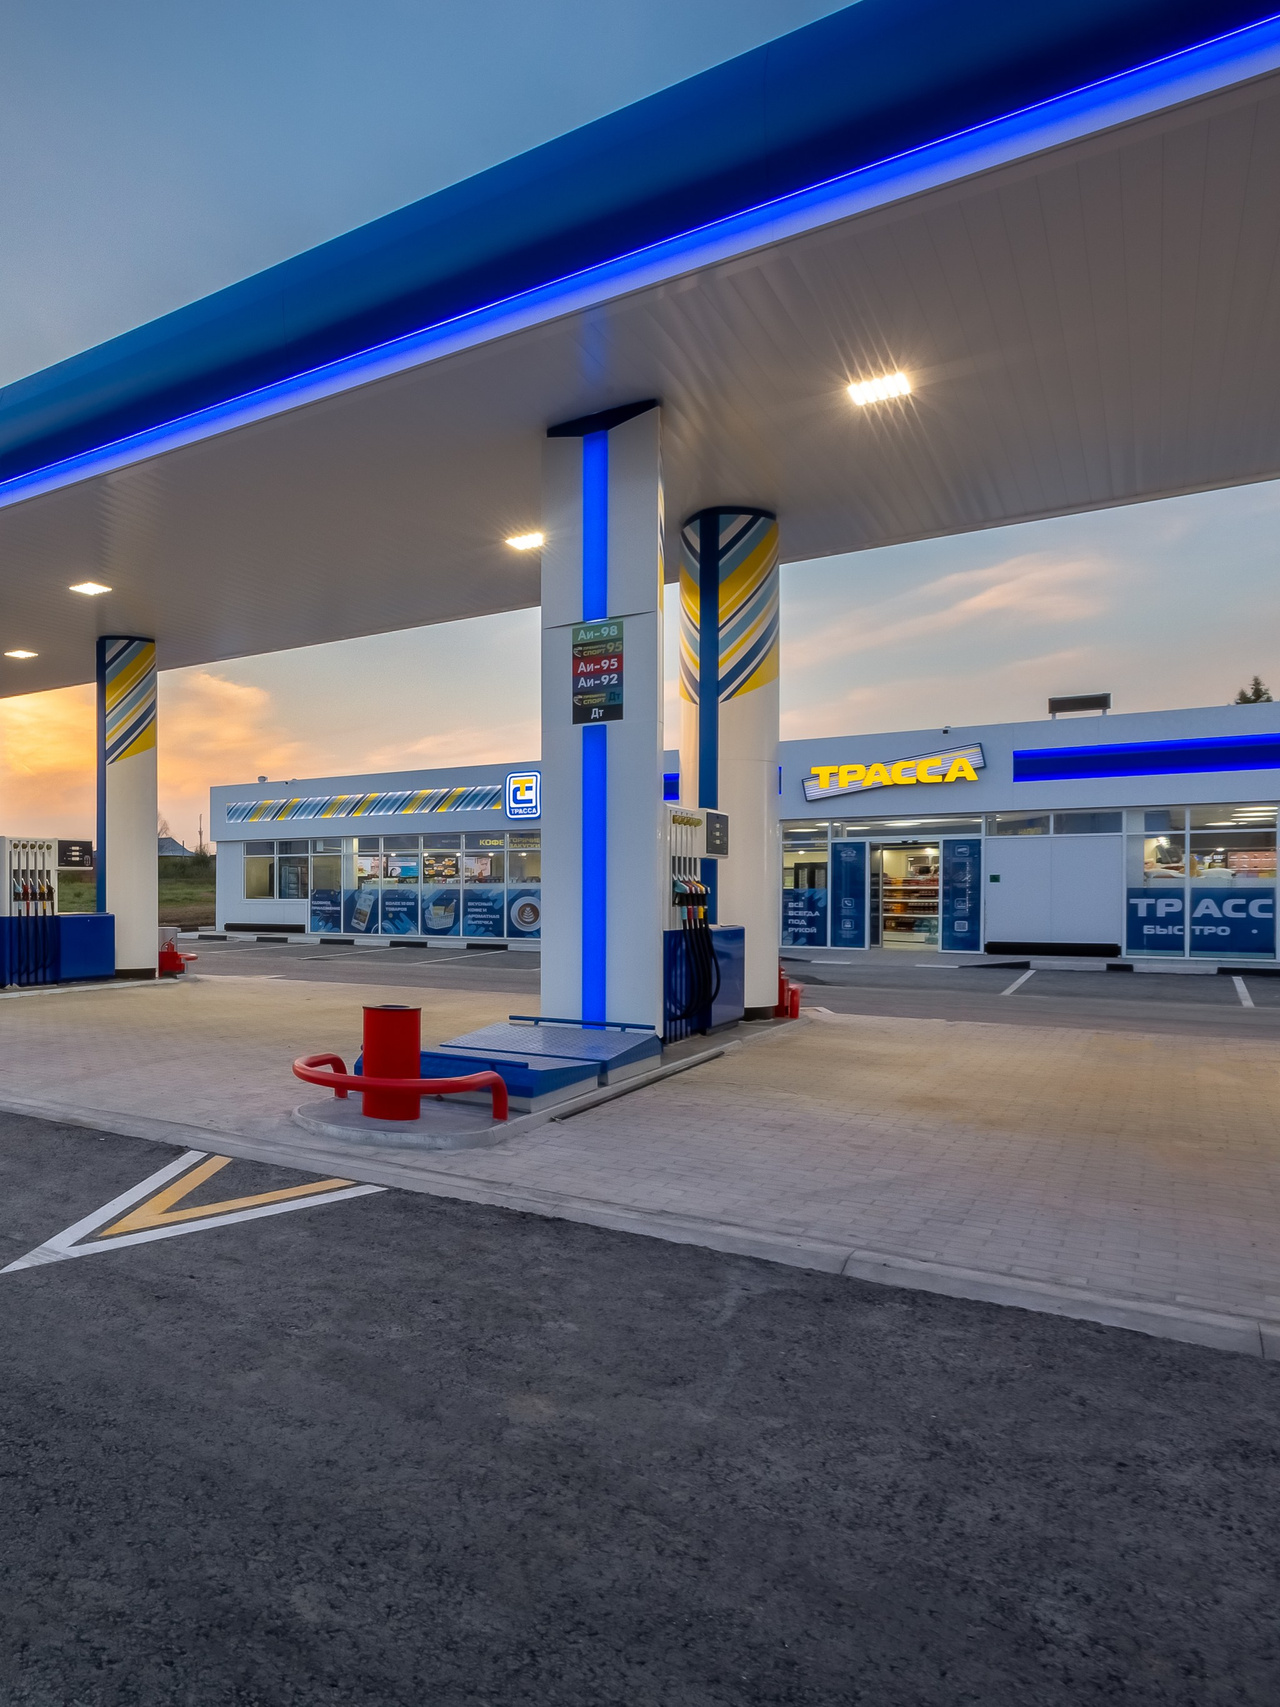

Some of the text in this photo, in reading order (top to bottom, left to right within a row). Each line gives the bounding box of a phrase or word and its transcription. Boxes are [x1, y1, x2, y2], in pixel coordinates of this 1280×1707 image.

[577, 625, 618, 641] Аи-98
[583, 641, 623, 656] СПОРТ 95
[577, 658, 618, 673] Аи-95
[577, 673, 618, 688] Аи-92
[583, 697, 606, 705] СПОРТ
[591, 708, 604, 720] Дт
[810, 757, 979, 789] ТРАССА
[510, 807, 537, 815] ТРАССА
[1143, 925, 1231, 936] БЫСТРО
